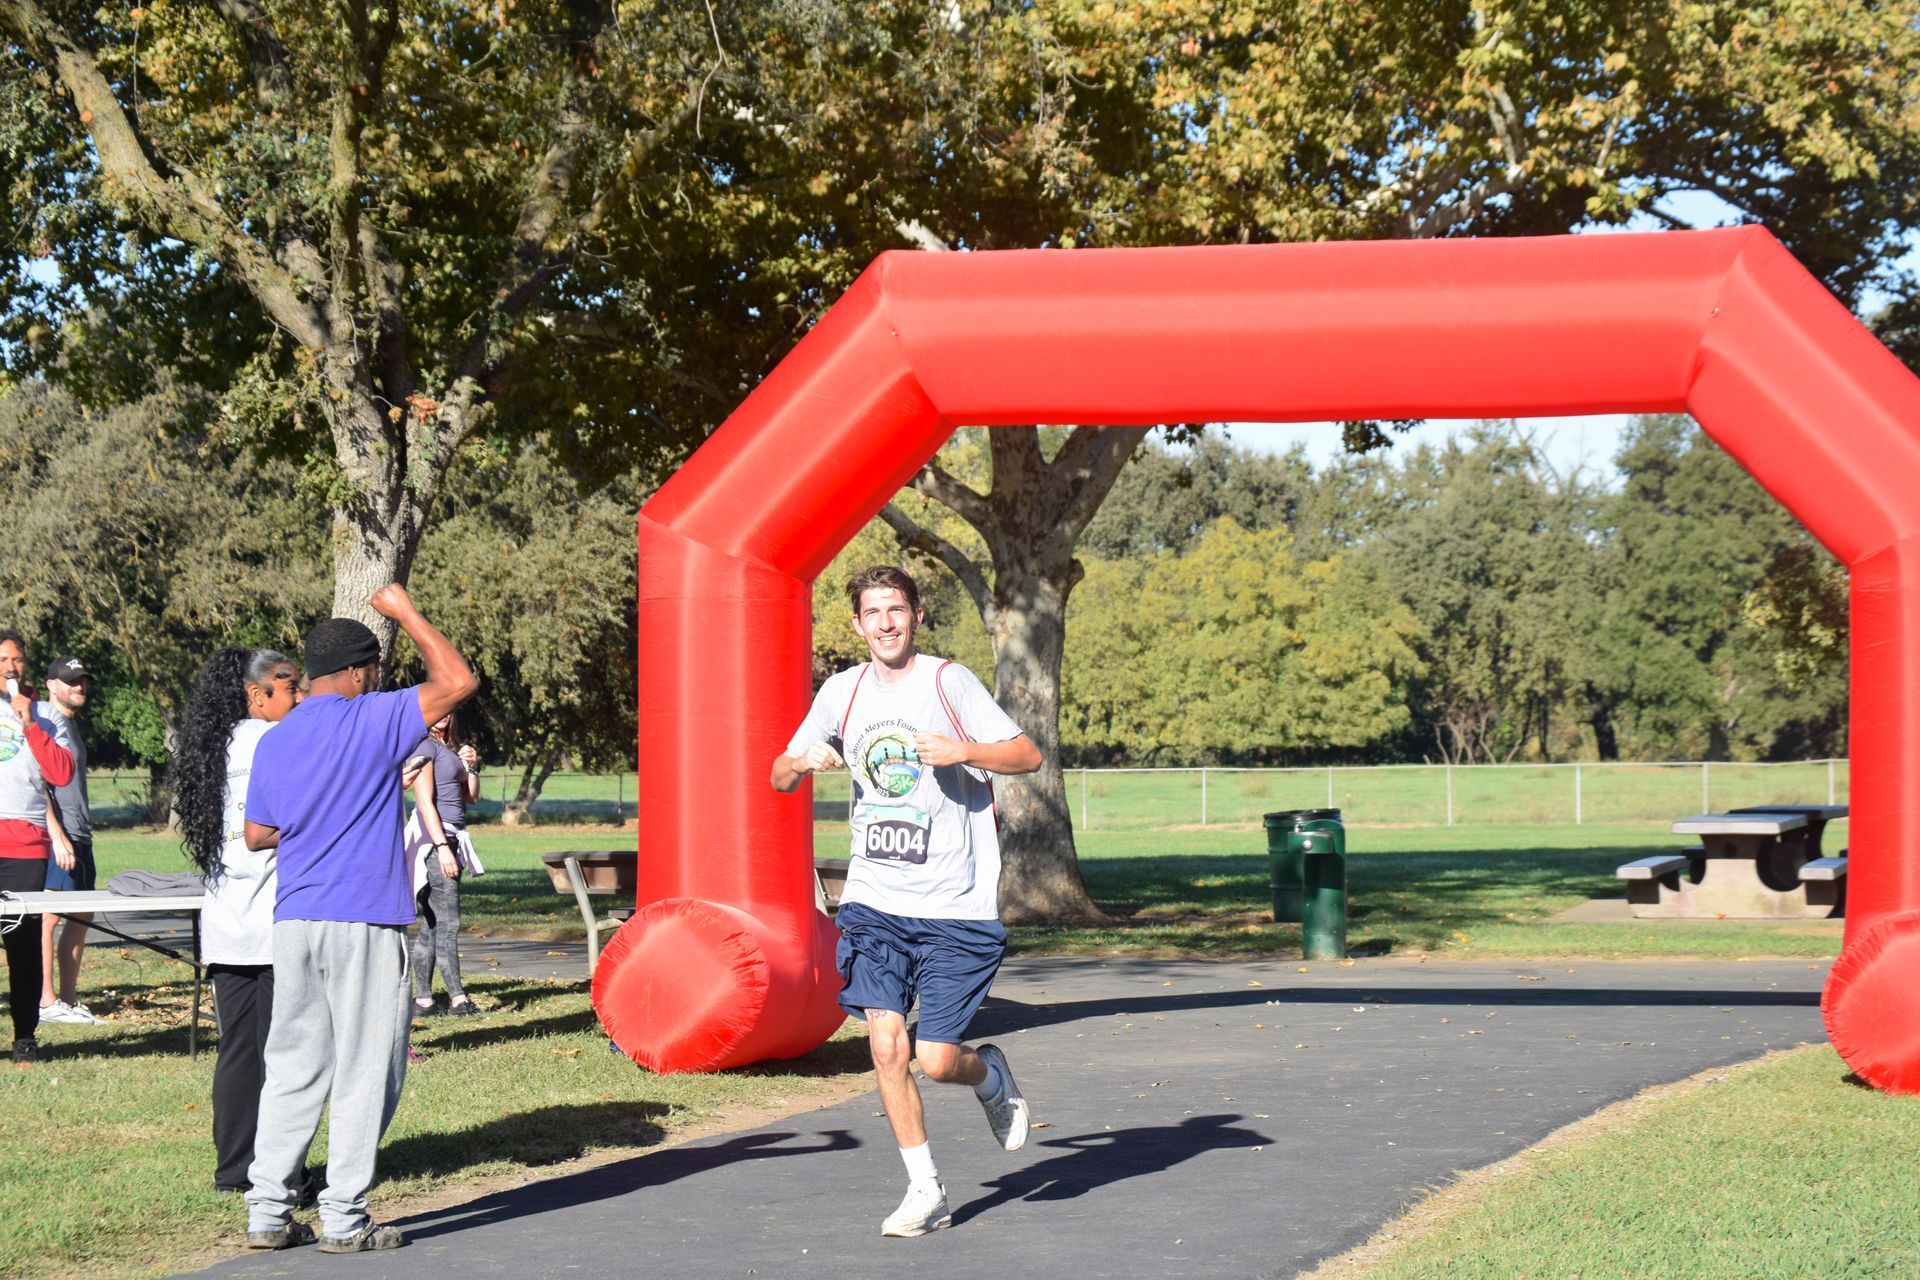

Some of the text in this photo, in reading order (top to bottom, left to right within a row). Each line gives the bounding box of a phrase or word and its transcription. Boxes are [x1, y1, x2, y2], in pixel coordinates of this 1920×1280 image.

[851, 734, 864, 767] Lamont
[865, 720, 895, 735] Meyers
[876, 786, 889, 798] 2025
[889, 774, 914, 792] 5K
[868, 825, 925, 855] 6004
